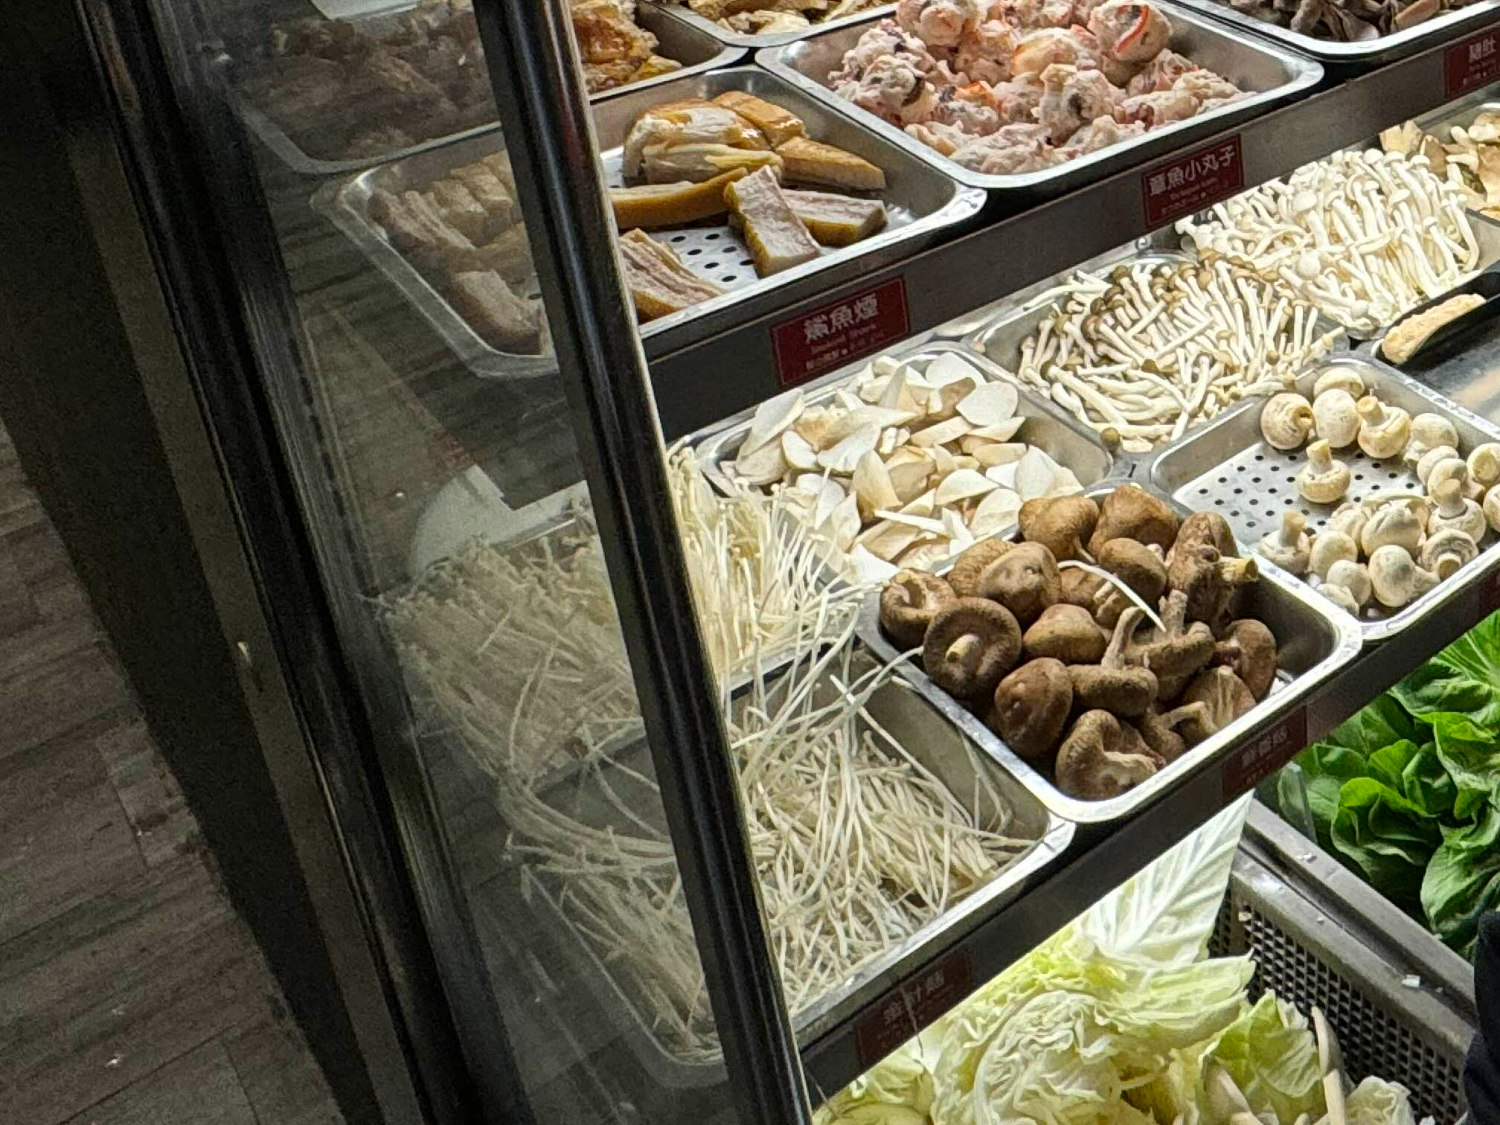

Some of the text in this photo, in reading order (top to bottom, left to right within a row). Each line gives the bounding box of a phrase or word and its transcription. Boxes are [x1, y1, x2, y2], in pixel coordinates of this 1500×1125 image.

[1149, 145, 1235, 196] 章魚小丸子
